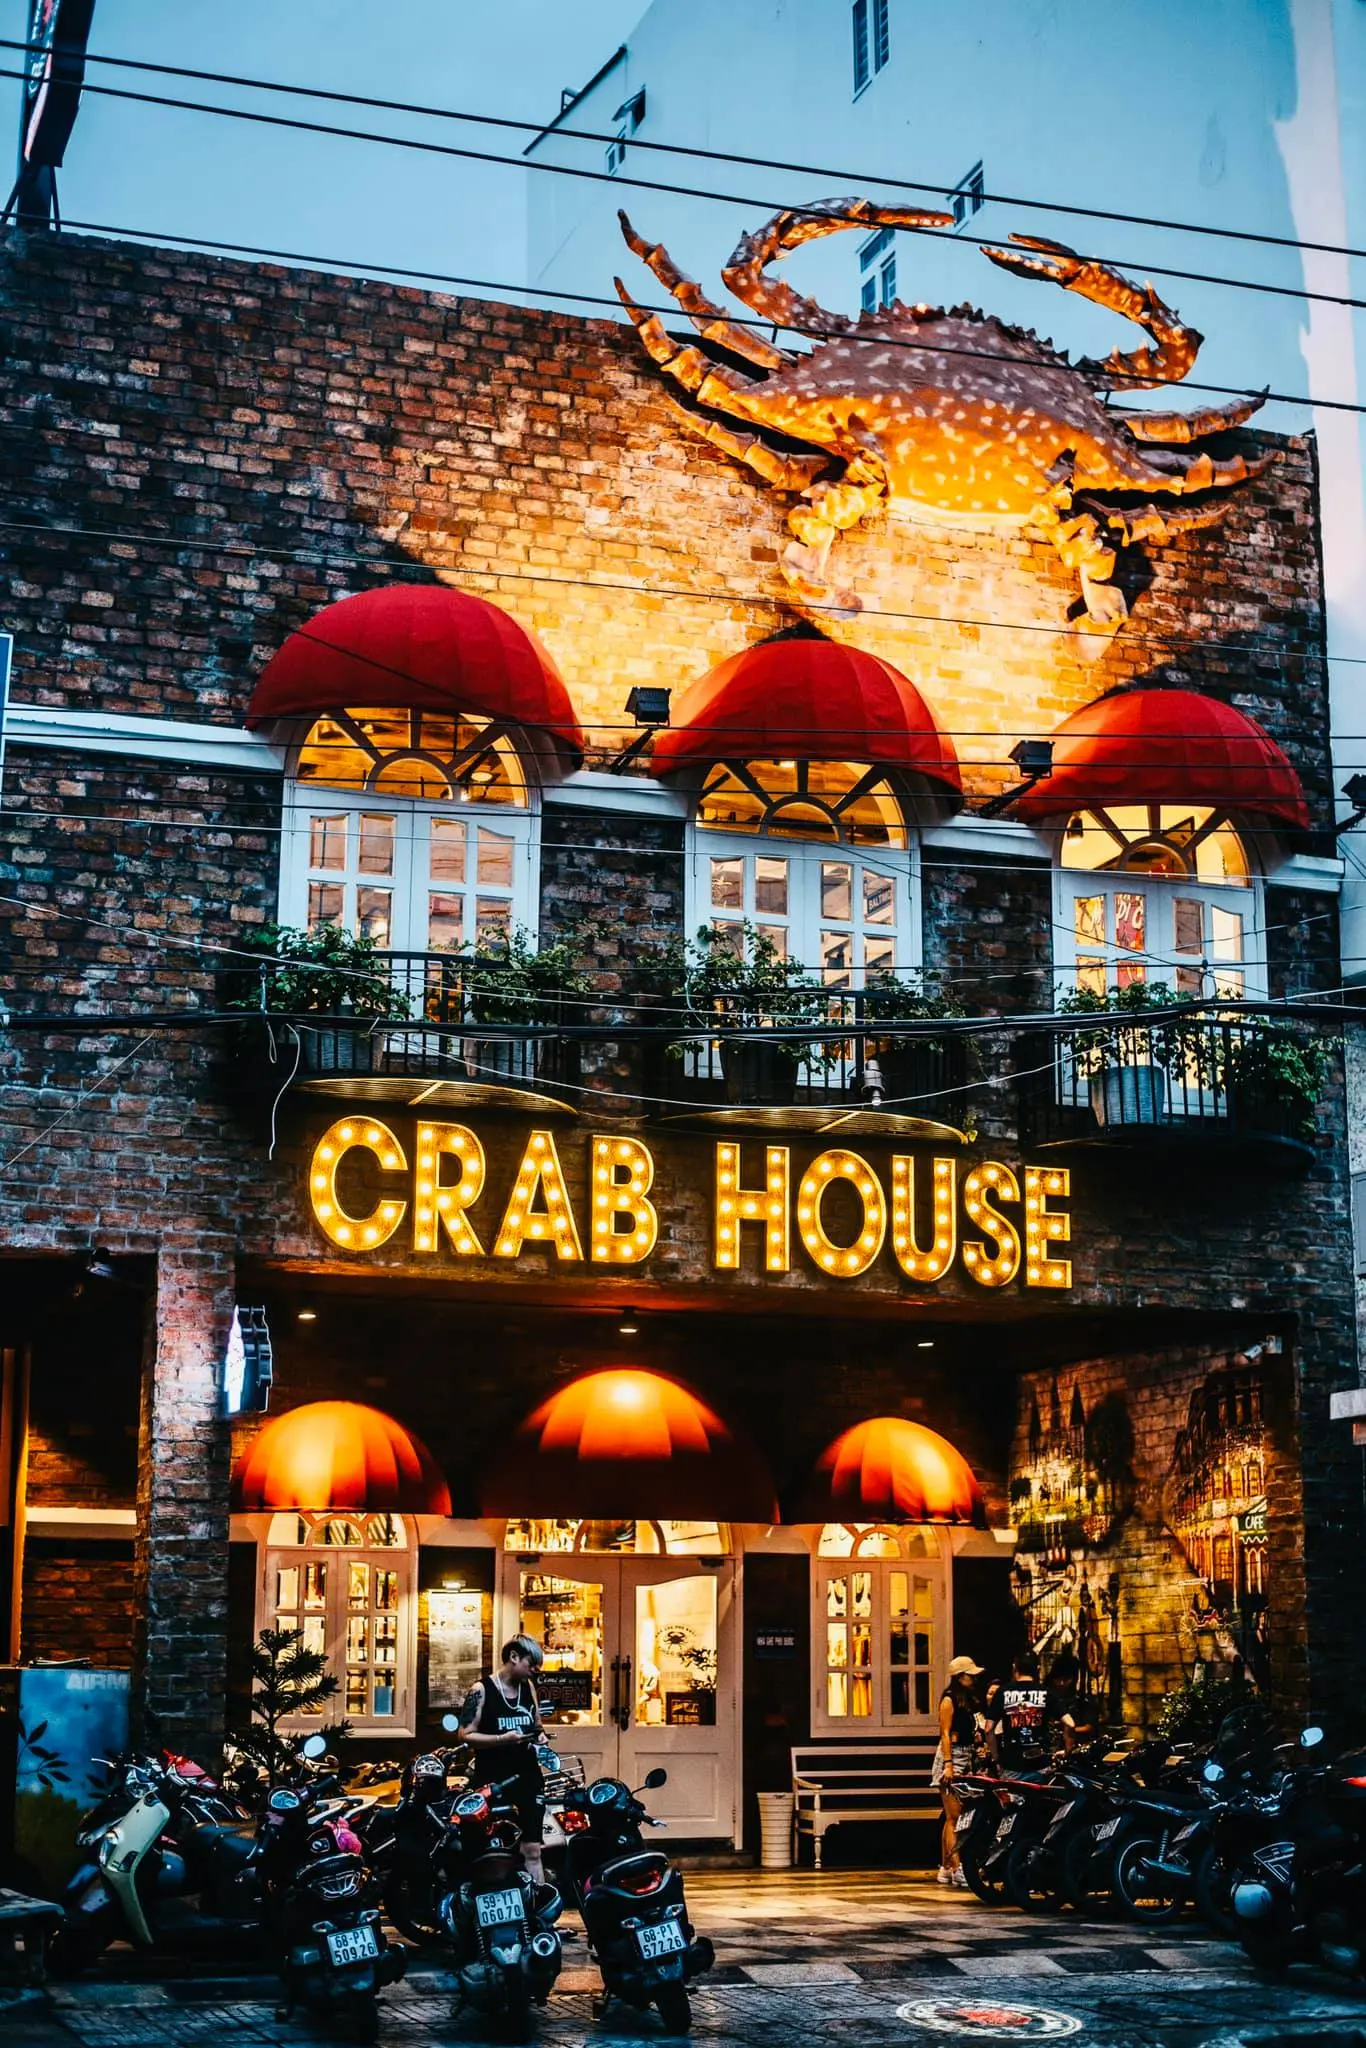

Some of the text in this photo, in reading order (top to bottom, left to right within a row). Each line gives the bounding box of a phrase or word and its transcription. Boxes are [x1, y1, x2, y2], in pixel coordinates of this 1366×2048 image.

[309, 1115, 1074, 1288] CRAB HOUSE
[1003, 1690, 1047, 1705] RIDE THE
[482, 1892, 513, 1910] 59-Y1
[481, 1904, 521, 1924] 060.70
[334, 1930, 366, 1948] 68-P1
[642, 1924, 673, 1943] 68-P1
[334, 1942, 375, 1963] 509.26
[643, 1935, 682, 1957] 572.26
